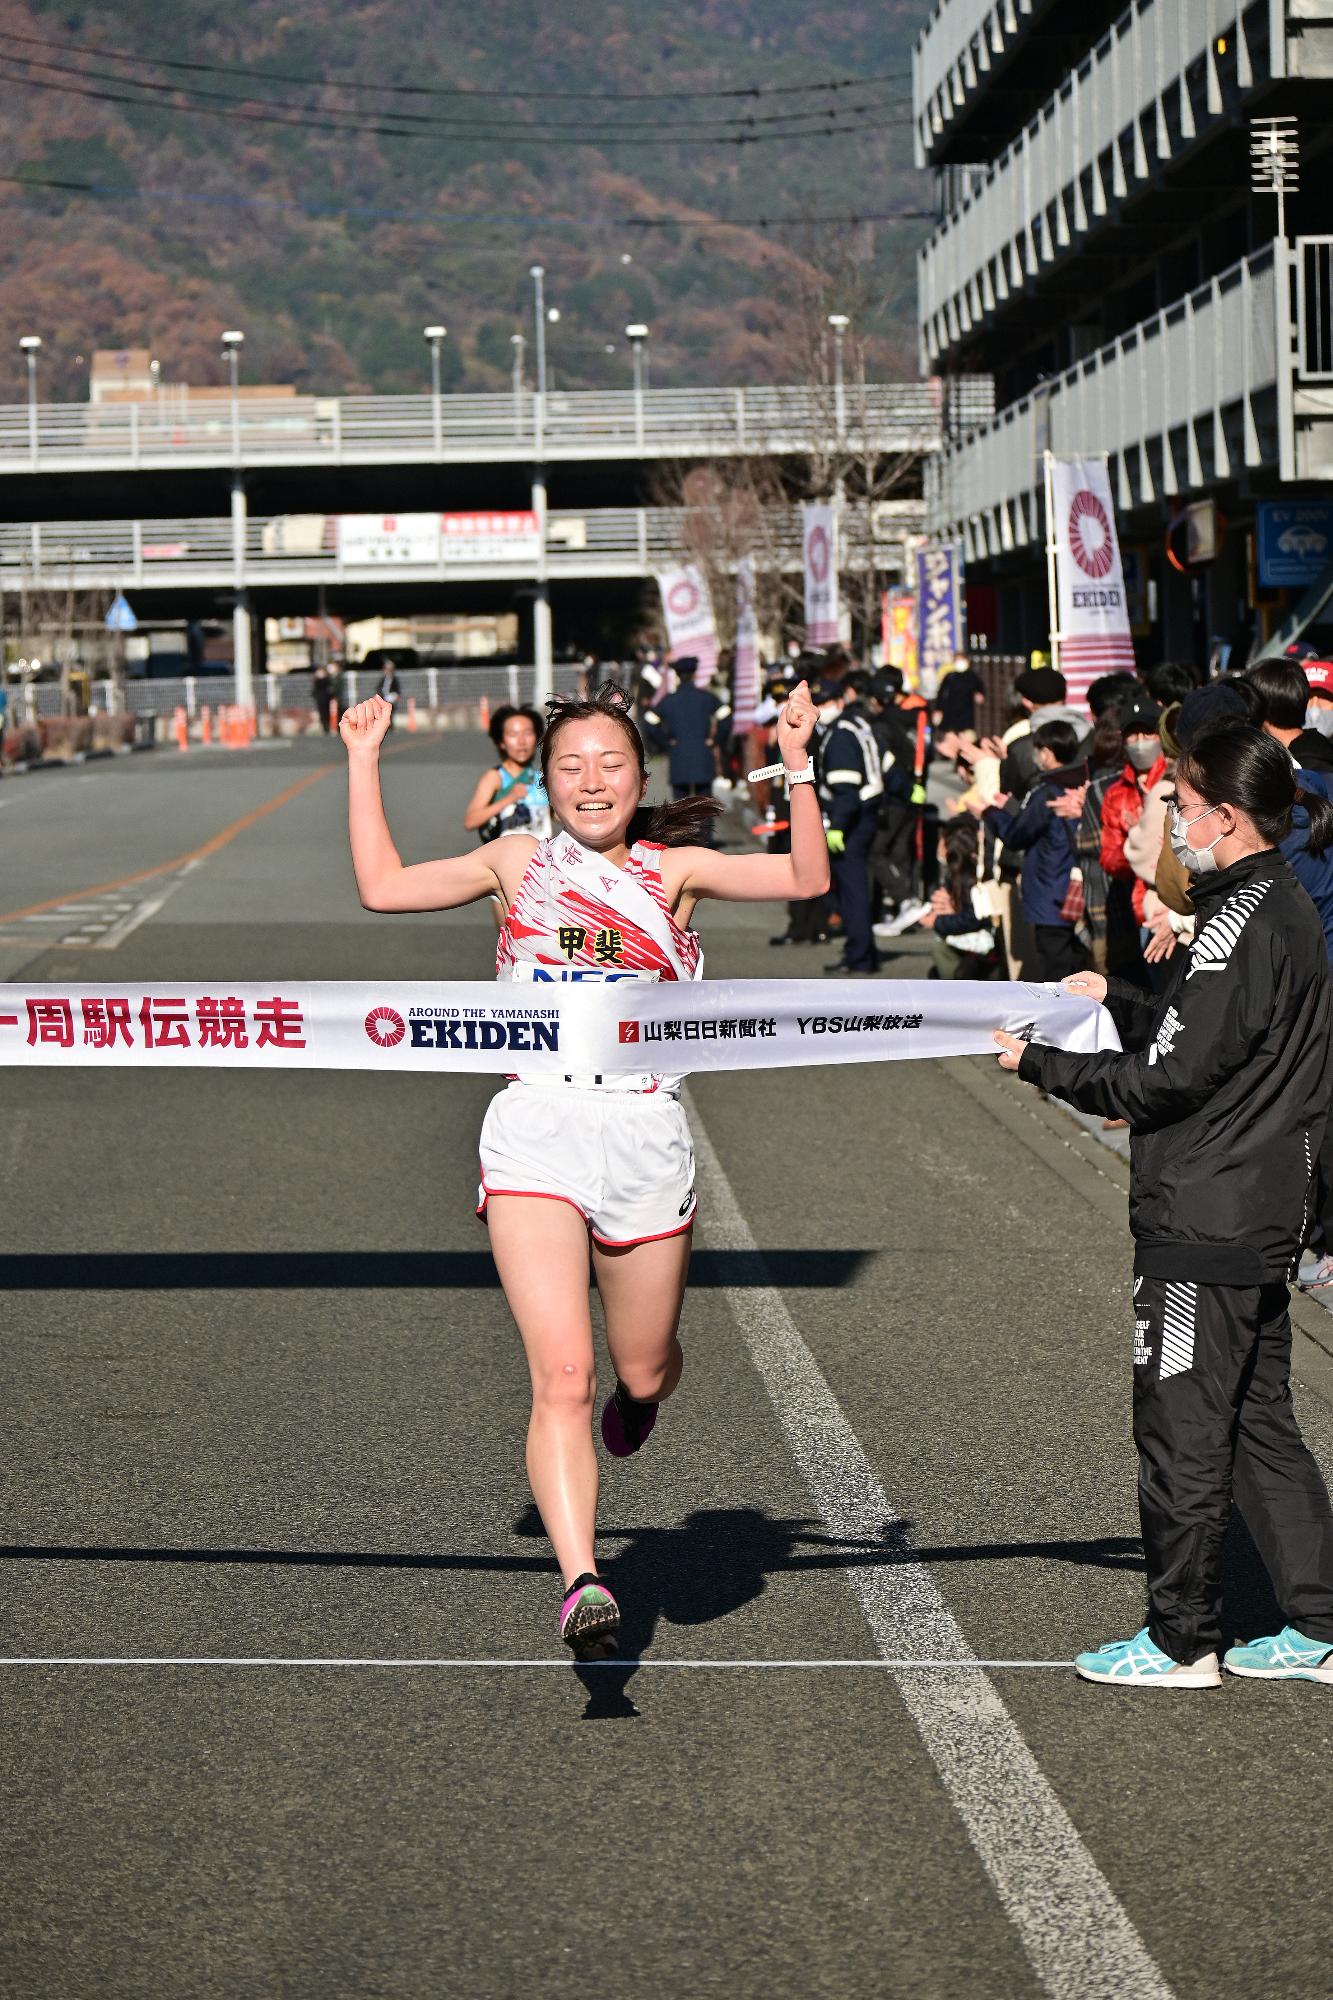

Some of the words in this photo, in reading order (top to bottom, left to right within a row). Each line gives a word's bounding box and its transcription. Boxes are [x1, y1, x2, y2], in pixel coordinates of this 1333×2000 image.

[558, 926, 624, 964] 甲斐
[408, 1008, 460, 1019] AROUND
[462, 1008, 486, 1019] THE
[490, 1008, 560, 1019] YAMANASHI
[408, 1020, 560, 1052] EKIDEN
[643, 1018, 777, 1043] 山梨日日新聞社
[796, 1014, 924, 1035] YBS山梨放送
[1135, 1320, 1151, 1330] SELF
